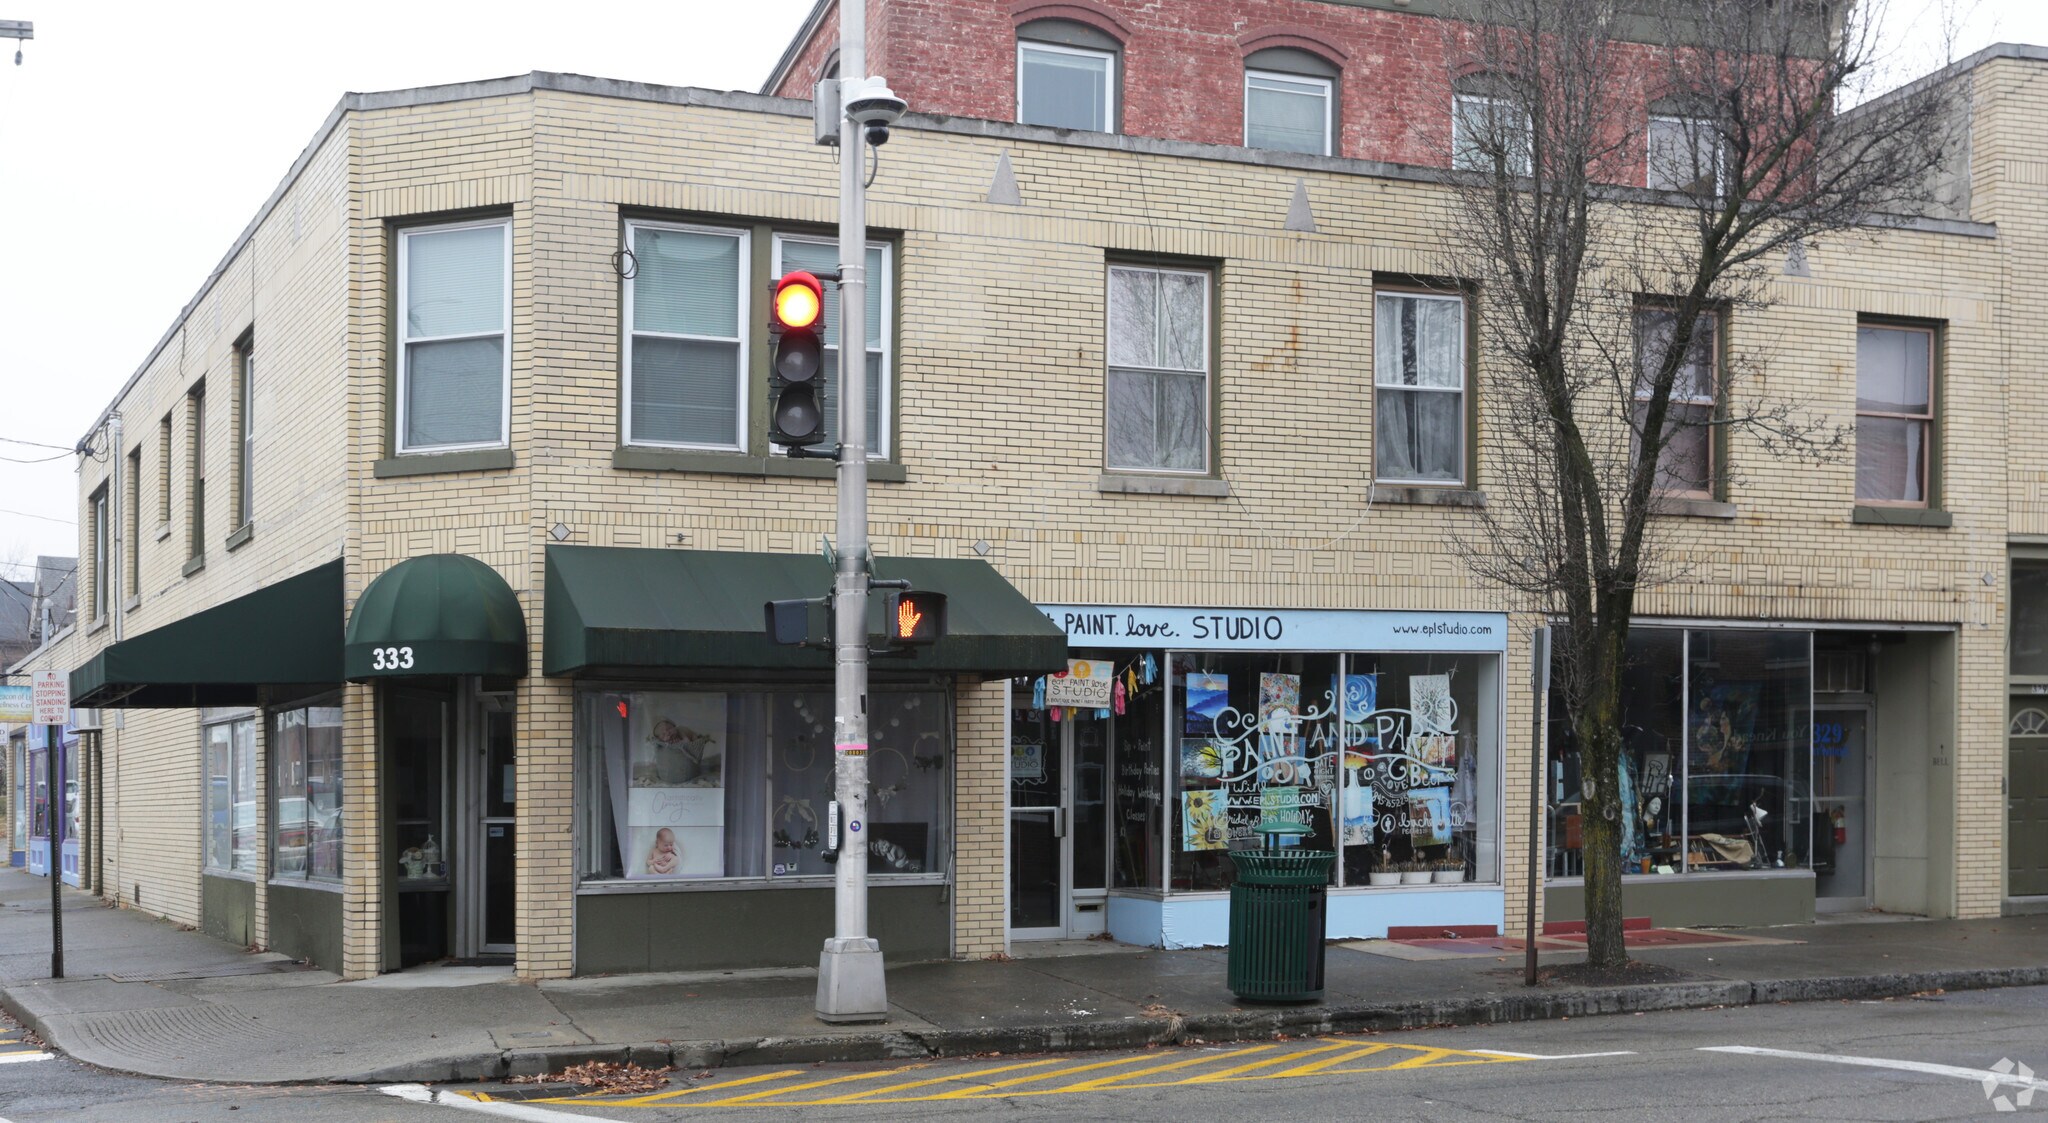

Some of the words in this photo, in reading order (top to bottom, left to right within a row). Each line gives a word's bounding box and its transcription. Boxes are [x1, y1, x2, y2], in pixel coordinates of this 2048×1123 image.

[1192, 615, 1284, 641] STUDIO
[1393, 622, 1492, 638] www.eplstudio.com
[372, 646, 415, 671] 333
[1052, 685, 1107, 699] STUDIO
[1220, 716, 1304, 779] PAINT
[1310, 721, 1368, 750] AND
[1375, 714, 1455, 769] PARTY
[1932, 757, 1949, 767] BELL
